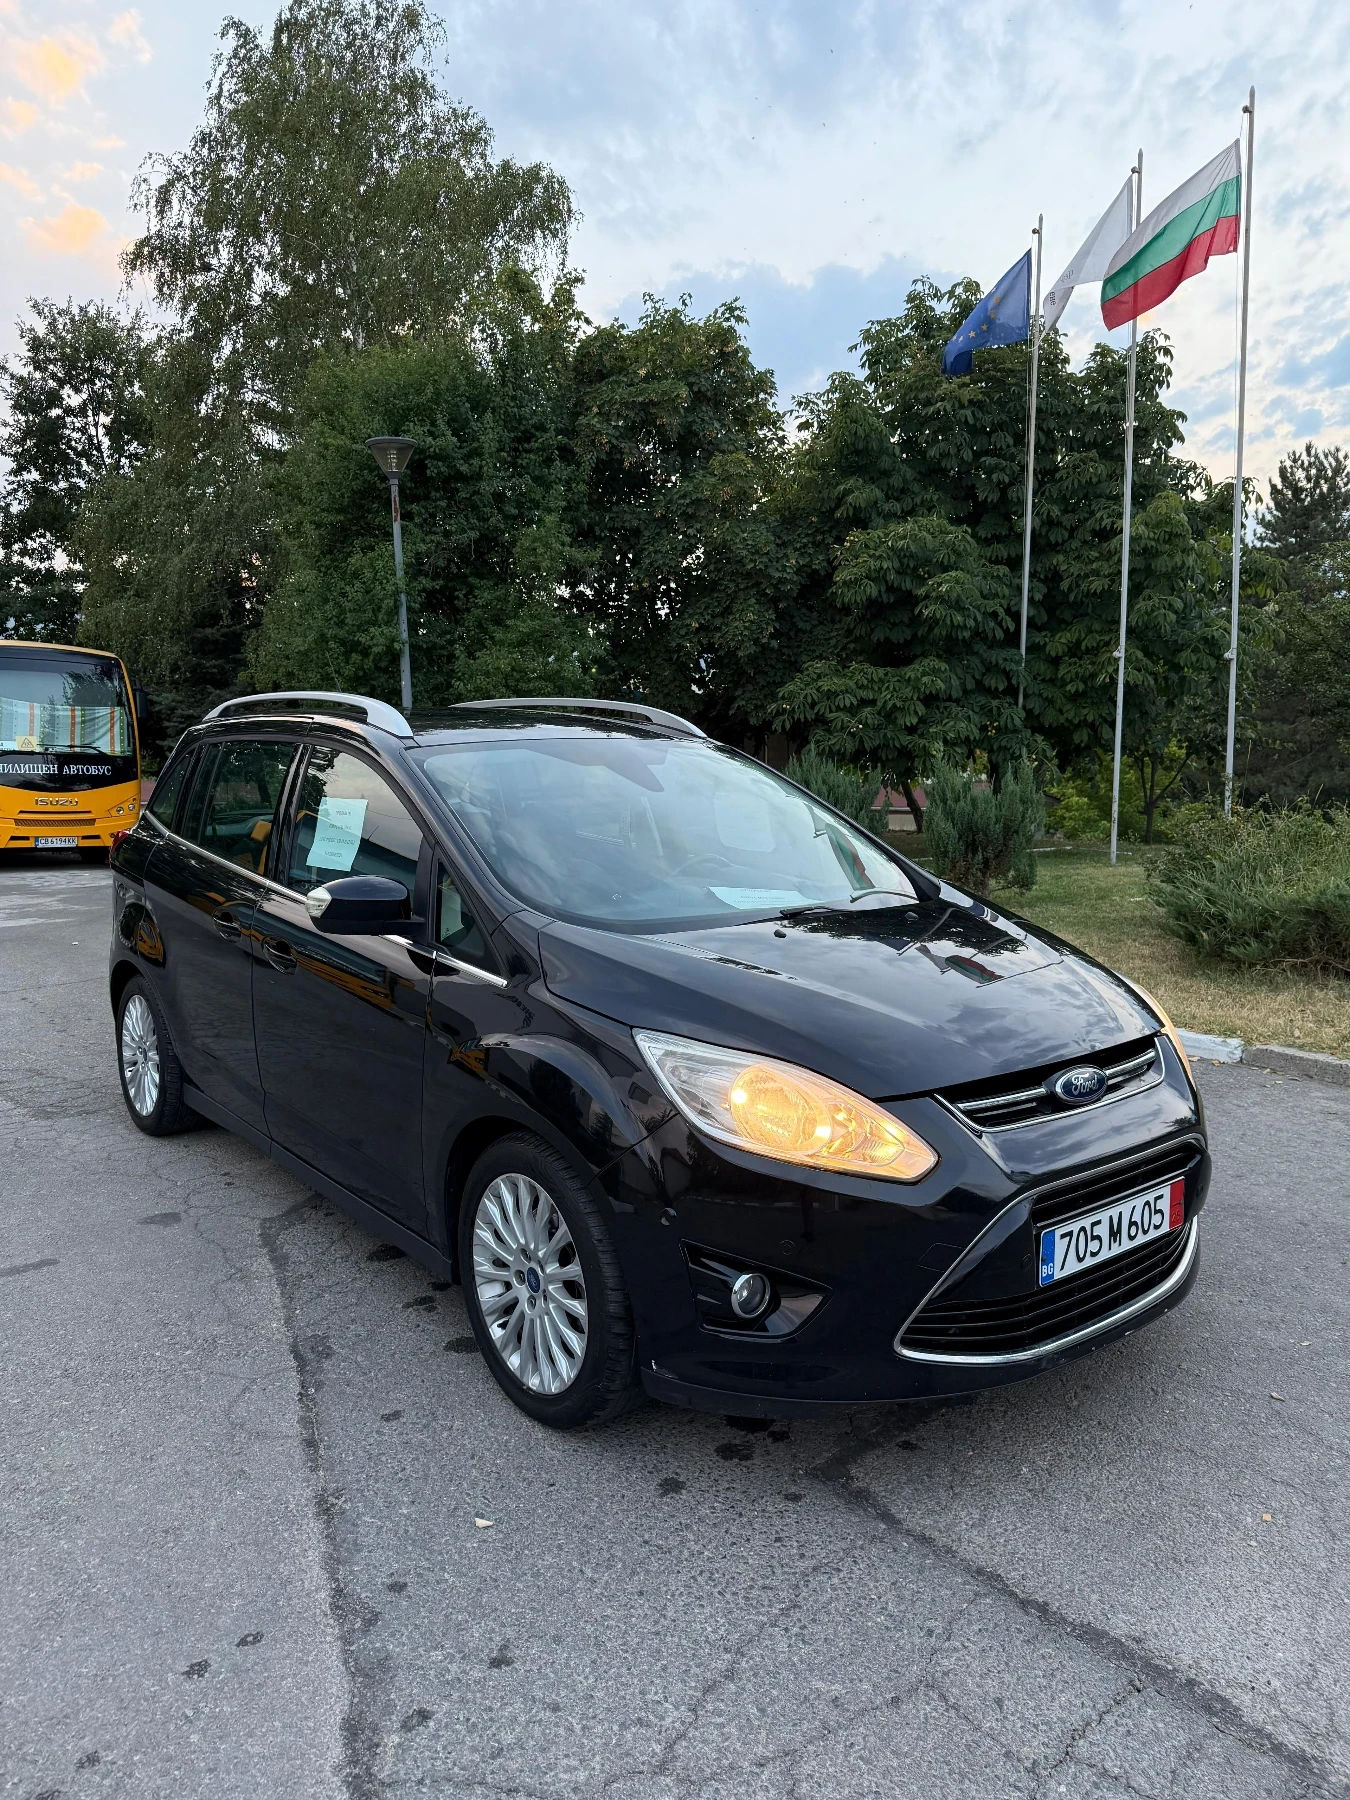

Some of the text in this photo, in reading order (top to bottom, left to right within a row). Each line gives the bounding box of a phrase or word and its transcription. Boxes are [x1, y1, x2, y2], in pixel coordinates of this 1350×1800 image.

[63, 764, 112, 775] АВТОБУС
[34, 797, 79, 806] ISUZU
[1071, 1072, 1099, 1096] Ford
[1041, 1263, 1054, 1277] BG
